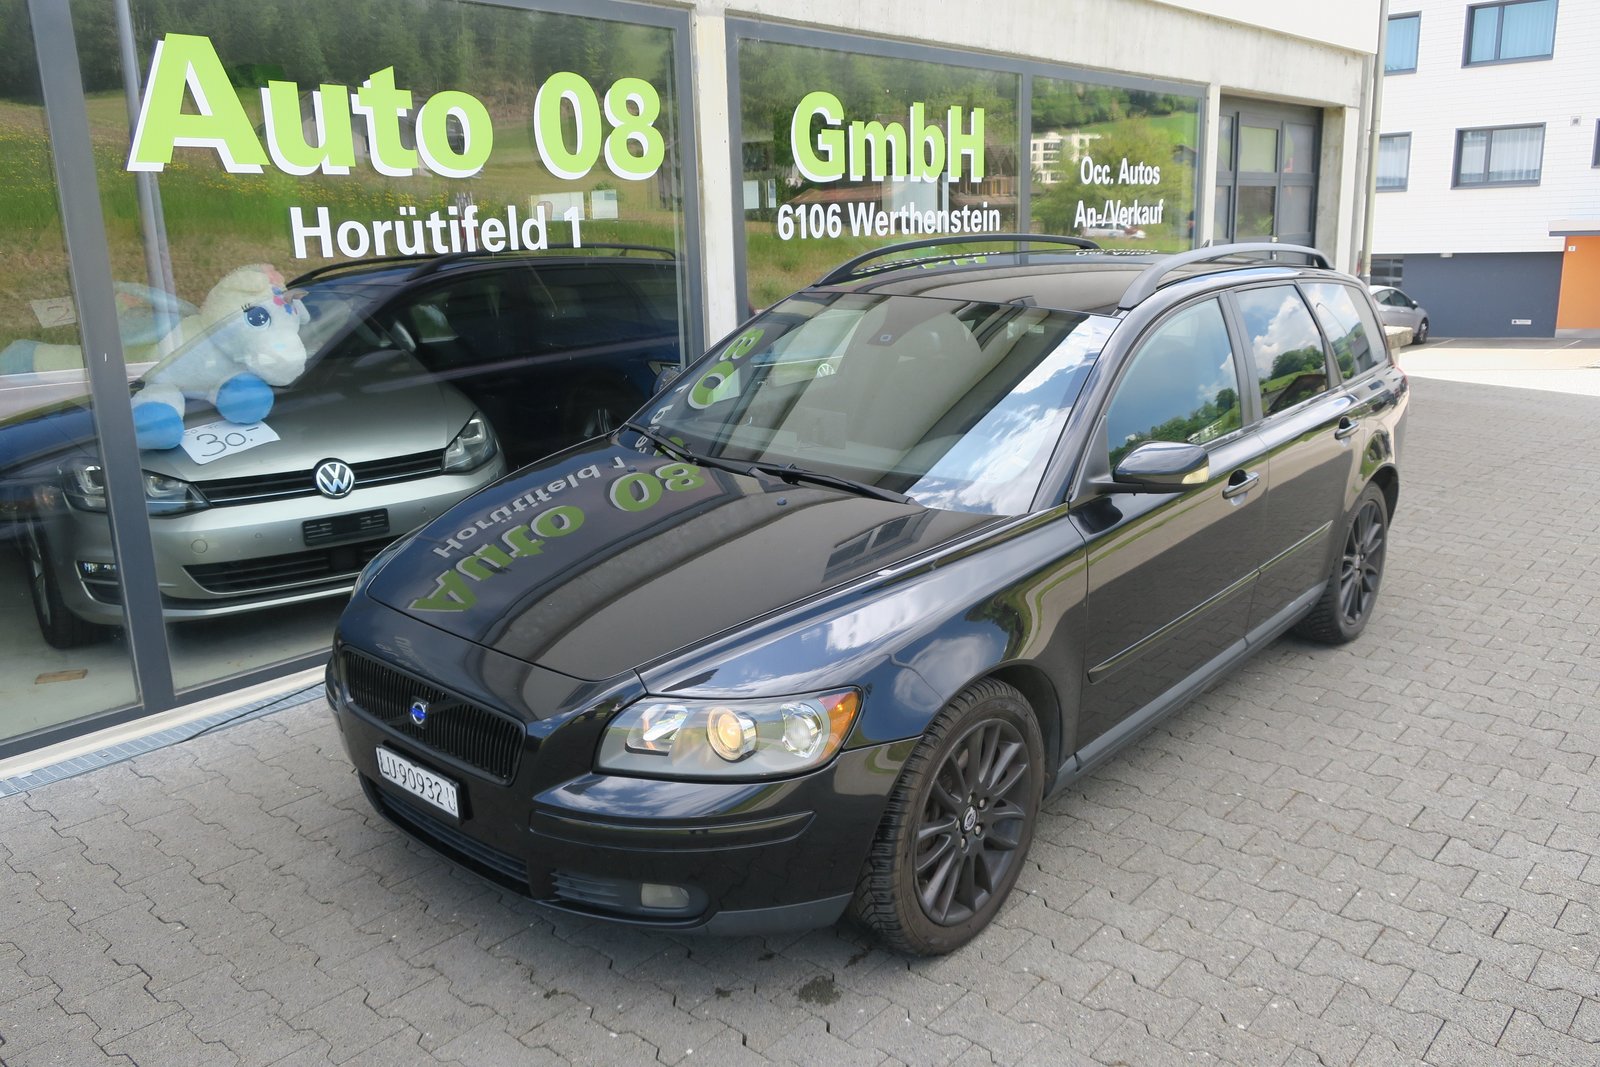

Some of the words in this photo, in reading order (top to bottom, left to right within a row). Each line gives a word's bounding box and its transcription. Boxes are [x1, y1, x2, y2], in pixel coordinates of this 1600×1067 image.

[127, 33, 494, 179] Auto
[534, 71, 665, 180] 08
[790, 91, 985, 183] GmbH
[1080, 155, 1114, 185] Occ.
[1117, 157, 1161, 185] Autos
[289, 205, 548, 259] Horütifeld
[563, 206, 582, 248] 1
[777, 203, 842, 241] 6106
[847, 201, 1001, 237] Werthenstein
[1073, 198, 1164, 230] An-/Verkauf
[196, 426, 260, 457] 30.-
[317, 461, 355, 496] VW
